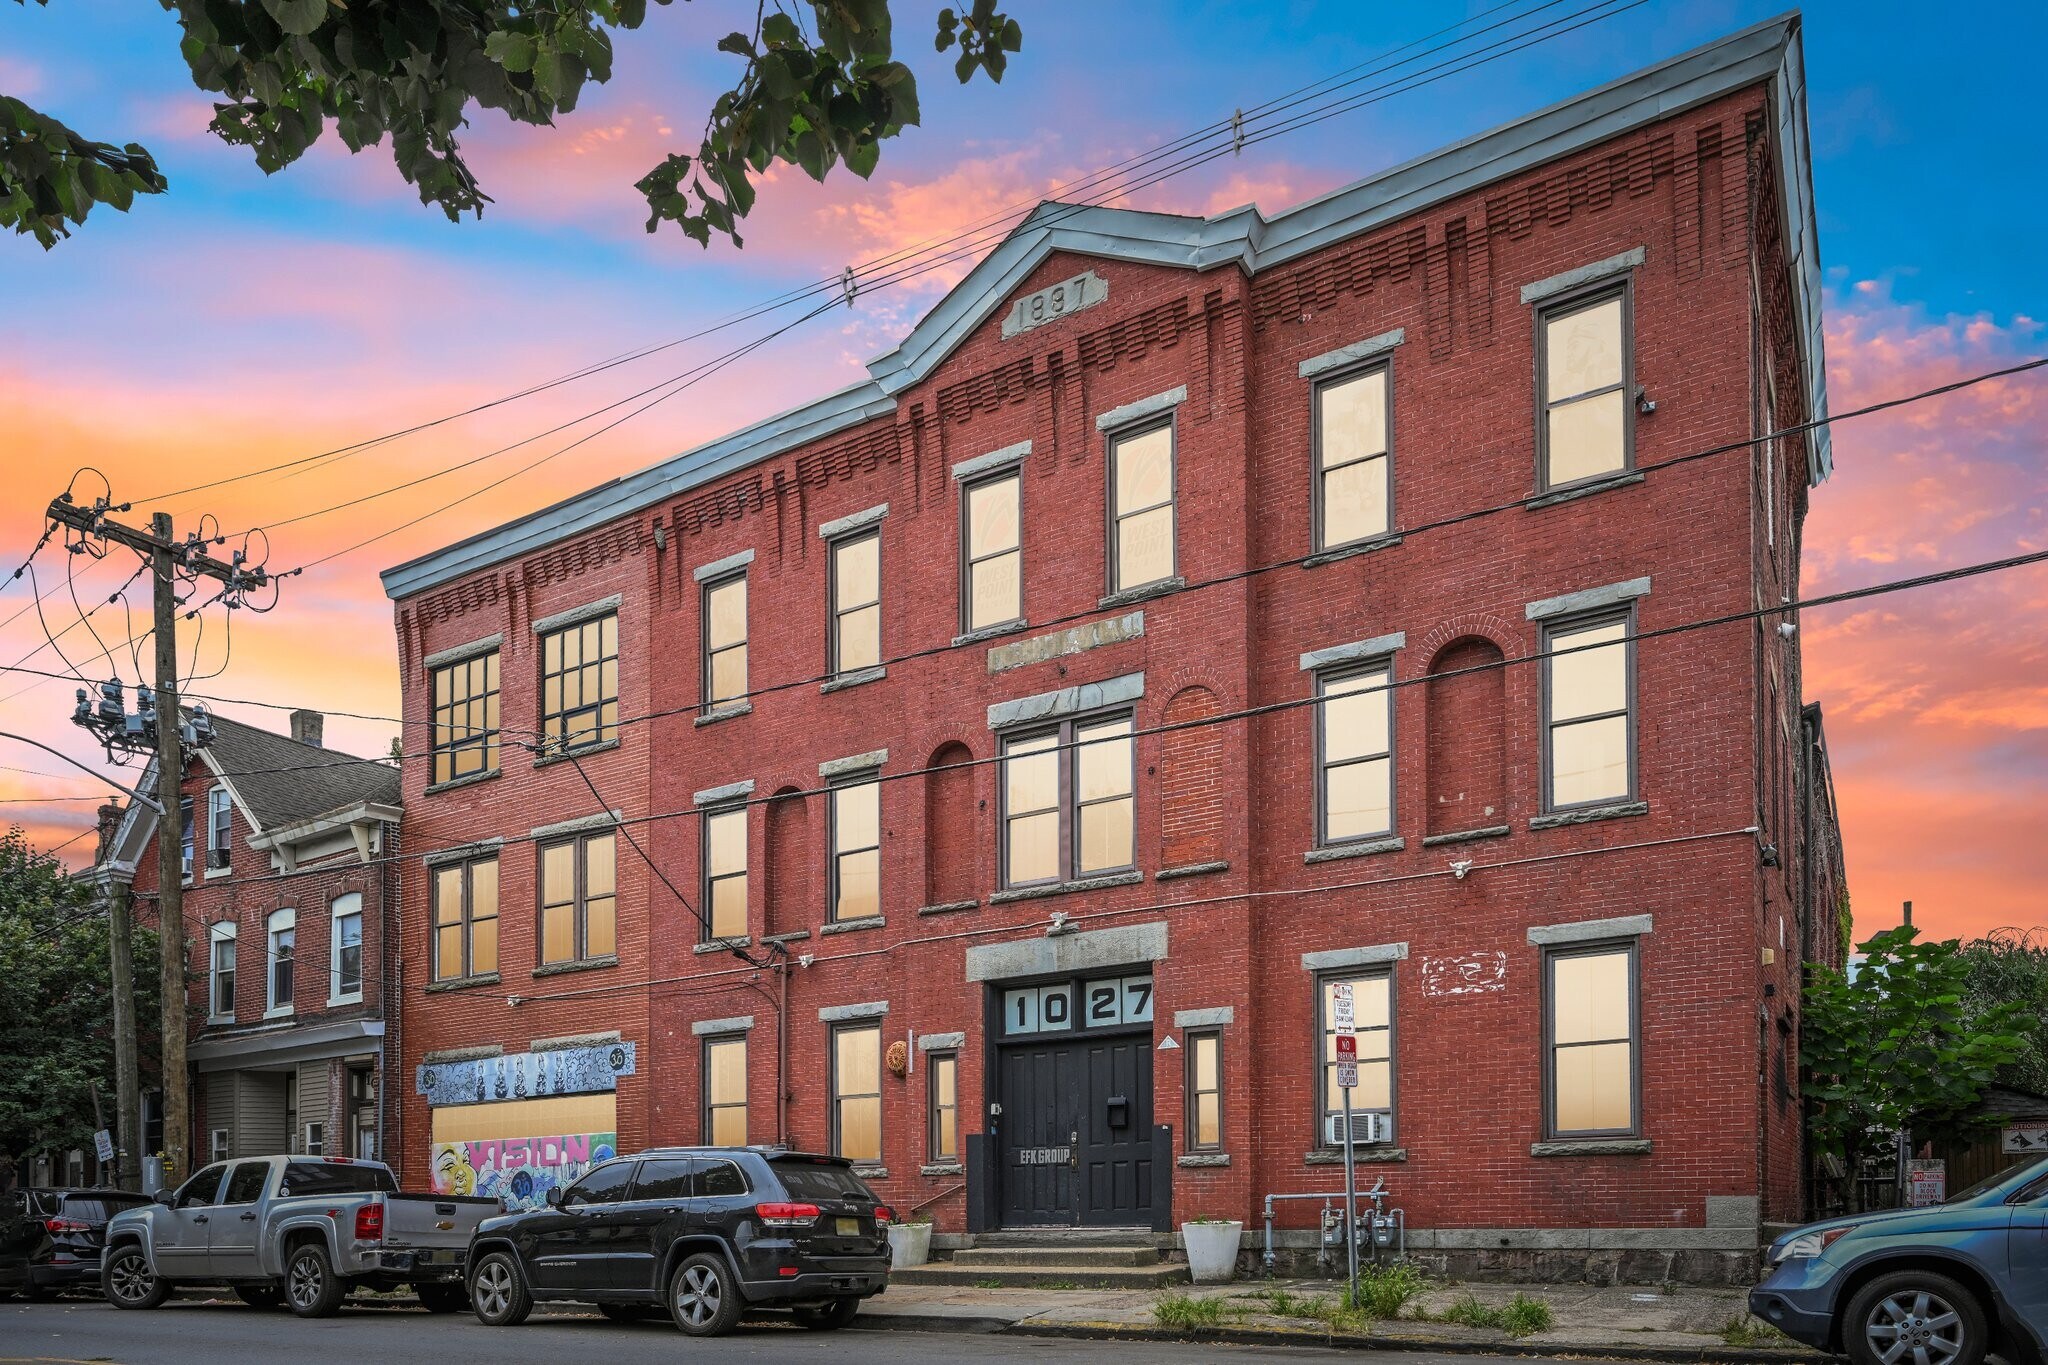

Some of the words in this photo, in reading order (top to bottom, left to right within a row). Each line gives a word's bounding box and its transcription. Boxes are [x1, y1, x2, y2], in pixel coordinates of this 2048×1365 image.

[1019, 277, 1086, 328] 1887
[1017, 982, 1152, 1027] 1027
[1341, 1040, 1350, 1050] NO
[1338, 1051, 1356, 1062] PARKING
[464, 1134, 590, 1171] VISION
[1020, 1149, 1037, 1164] EFK
[1038, 1148, 1070, 1164] GROUP
[1914, 1172, 1924, 1180] NO
[1924, 1172, 1944, 1180] PARKING
